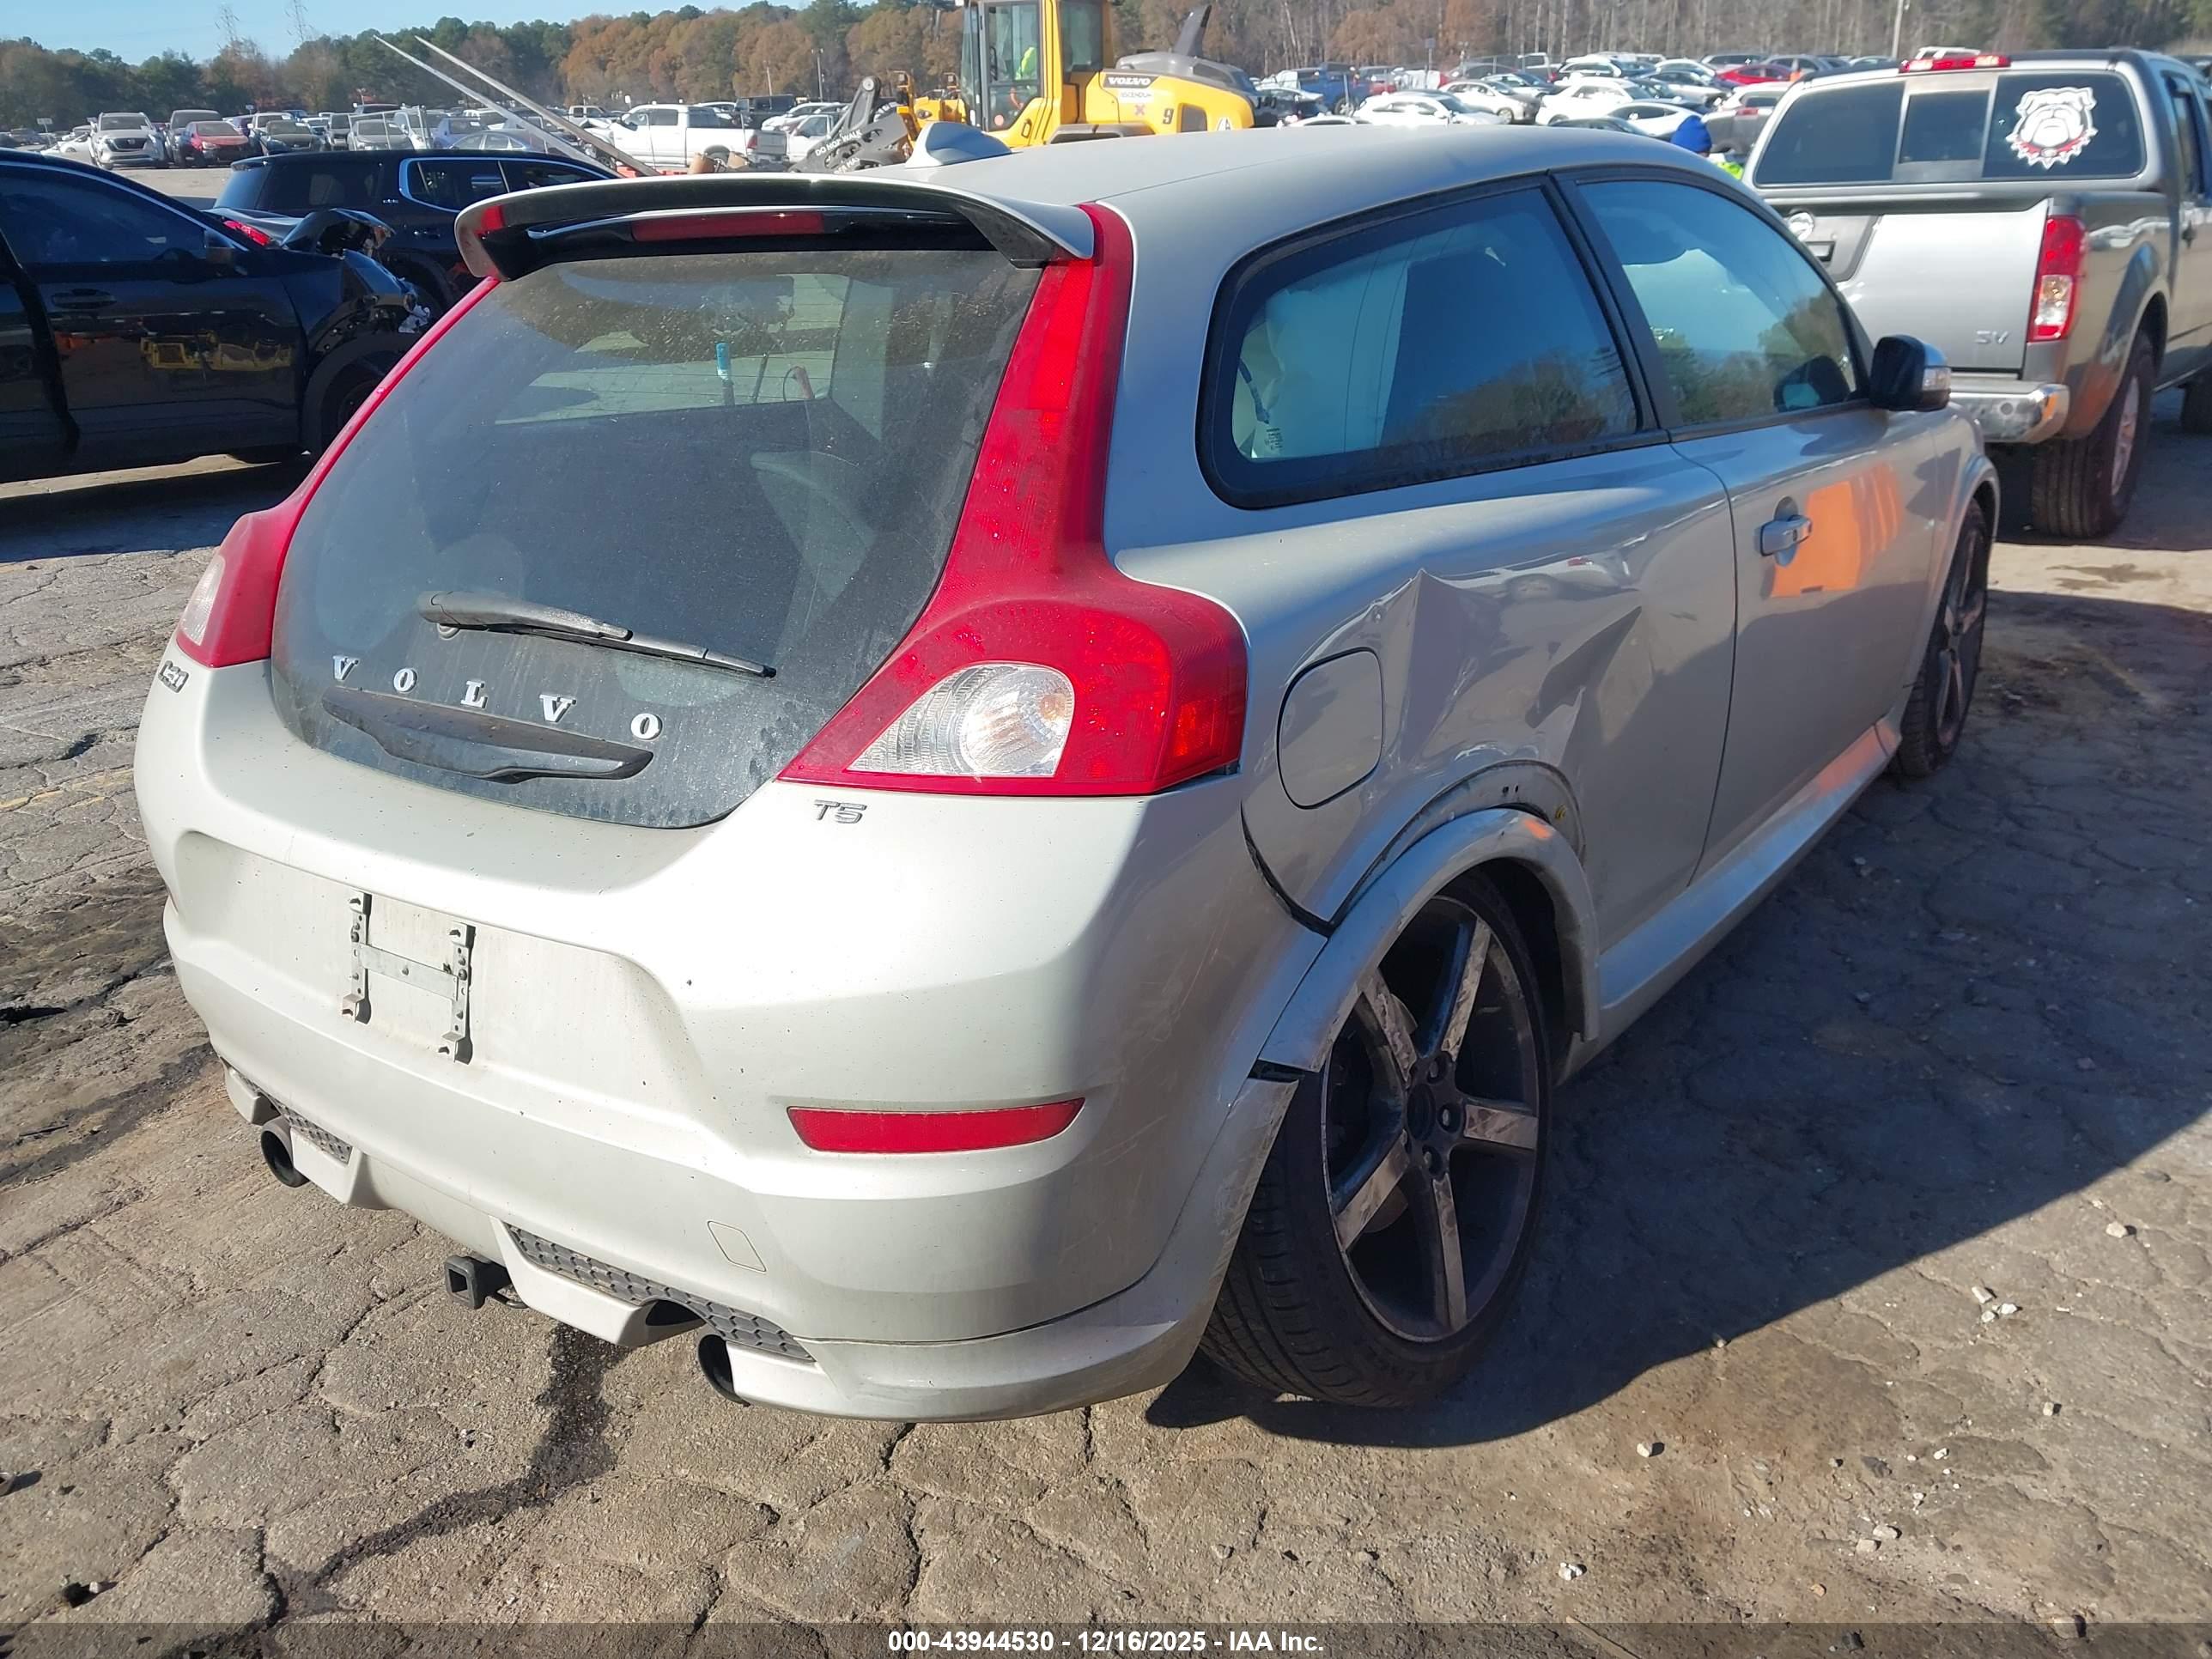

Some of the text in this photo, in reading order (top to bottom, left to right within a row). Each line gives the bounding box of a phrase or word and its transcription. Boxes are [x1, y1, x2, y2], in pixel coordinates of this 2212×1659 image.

[1108, 76, 1152, 85] VOLVO
[1163, 108, 1174, 125] 9
[815, 129, 862, 156] DO NOT WALK
[1975, 330, 2008, 344] SV
[331, 655, 664, 741] VOLVO
[814, 799, 867, 824] T5
